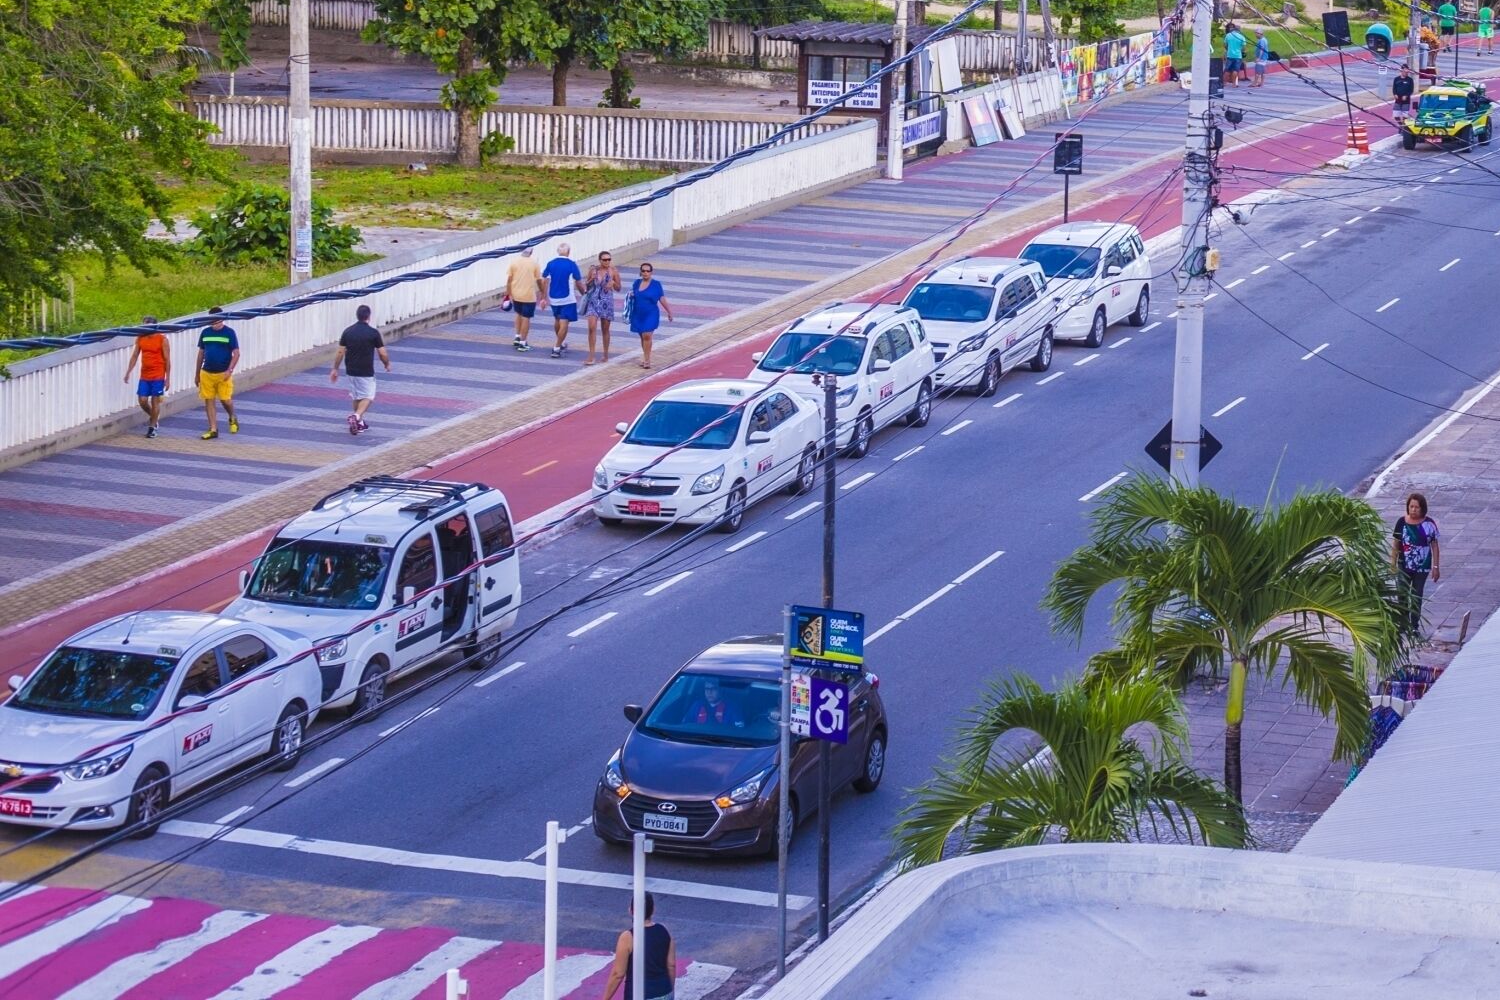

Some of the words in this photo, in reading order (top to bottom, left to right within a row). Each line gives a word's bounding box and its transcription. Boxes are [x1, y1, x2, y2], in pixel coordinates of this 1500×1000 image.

[402, 613, 425, 635] TAXI
[791, 716, 809, 726] RAMPA
[186, 730, 211, 751] TAXI
